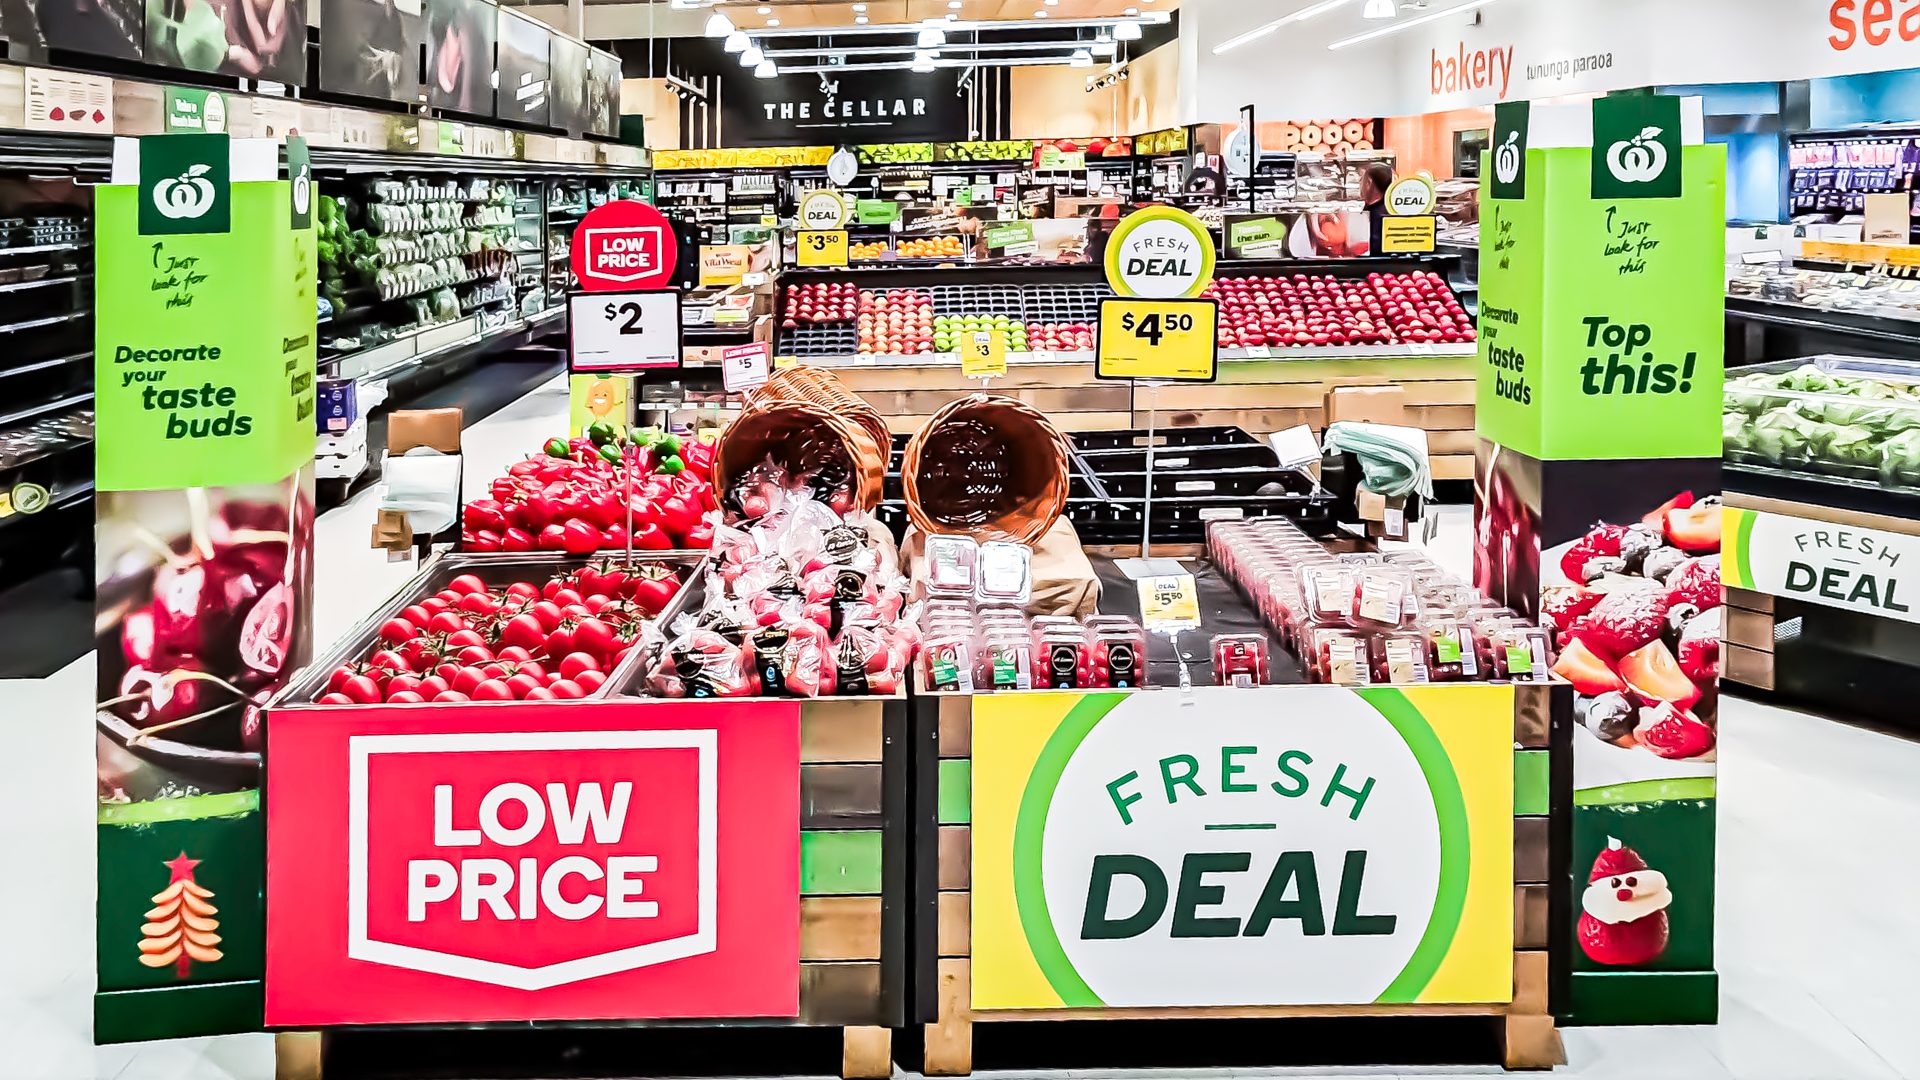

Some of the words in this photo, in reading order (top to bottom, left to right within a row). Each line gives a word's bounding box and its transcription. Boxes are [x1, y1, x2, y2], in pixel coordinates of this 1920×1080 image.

[1431, 41, 1513, 99] bakery
[1527, 60, 1569, 80] tununga
[1573, 52, 1613, 78] paraoa
[763, 102, 811, 120] THE
[823, 98, 926, 118] CELLAR
[807, 211, 837, 220] DEAL
[1394, 197, 1426, 206] DEAL
[1618, 221, 1651, 238] Just
[602, 237, 645, 253] LOW
[1132, 237, 1190, 254] FRESH
[1637, 237, 1660, 257] for
[597, 253, 651, 268] PRICE
[1126, 258, 1193, 277] DEAL
[1619, 258, 1646, 276] this
[184, 271, 209, 291] for
[604, 302, 643, 335] $2
[1580, 316, 1652, 356] Top
[114, 344, 222, 364] Decorate
[1488, 341, 1525, 373] taste
[122, 370, 167, 388] your
[1496, 370, 1532, 406] buds
[1580, 352, 1697, 395] this!
[142, 382, 237, 411] taste
[166, 409, 252, 440] buds
[1794, 531, 1901, 568] FRESH
[1784, 560, 1909, 613] DEAL
[1106, 746, 1377, 825] FRESH
[433, 781, 633, 847] LOW
[407, 855, 659, 923] PRICE
[1080, 850, 1397, 940] DEAL
